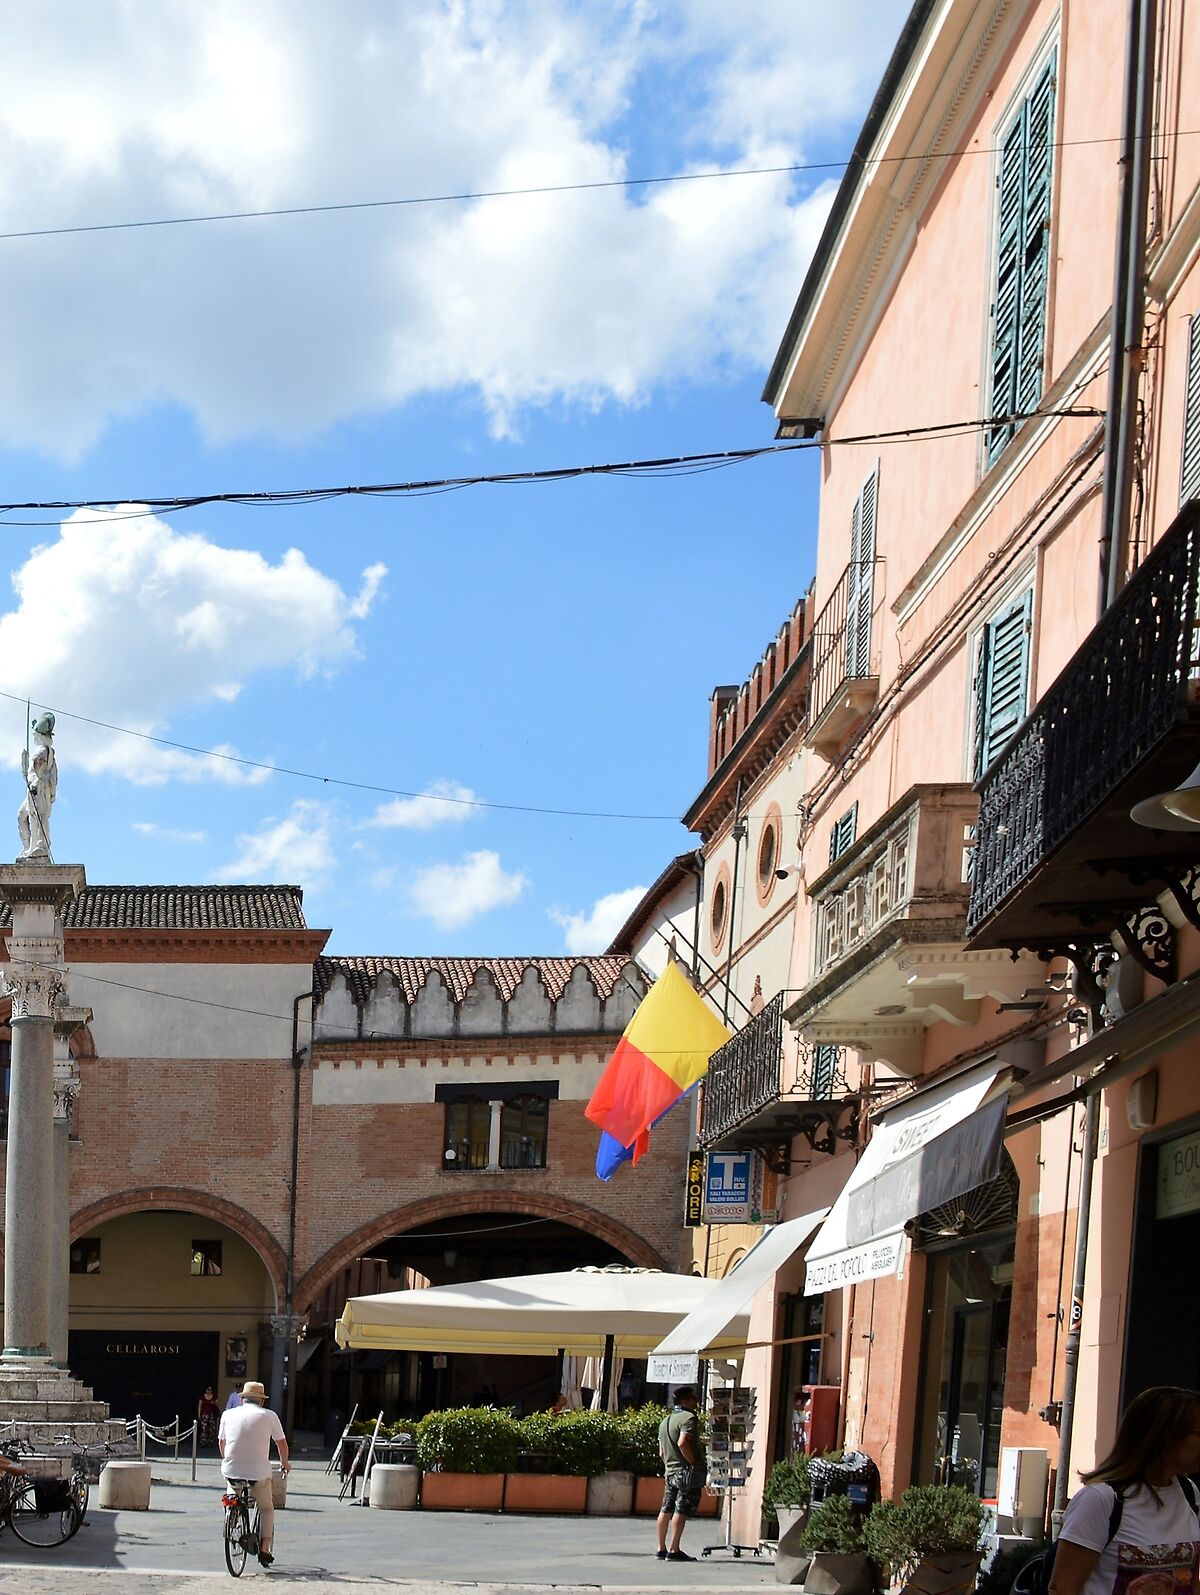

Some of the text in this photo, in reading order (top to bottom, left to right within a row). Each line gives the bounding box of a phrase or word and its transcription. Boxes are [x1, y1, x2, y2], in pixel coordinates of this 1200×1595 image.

[892, 1115, 942, 1154] SWEET
[712, 1155, 746, 1190] T
[689, 1184, 701, 1219] ORE
[106, 1344, 179, 1354] CELLAROSI
